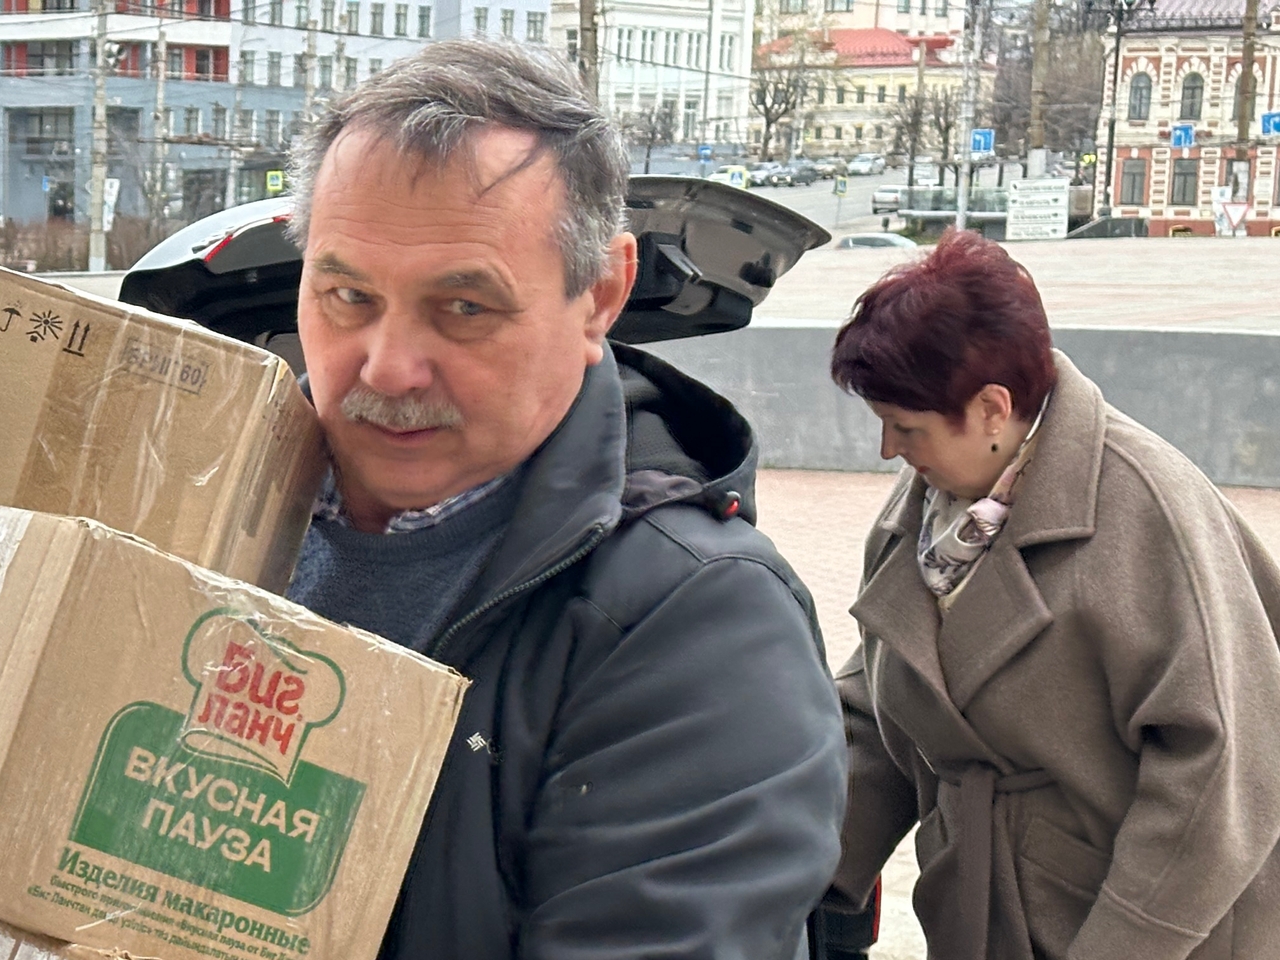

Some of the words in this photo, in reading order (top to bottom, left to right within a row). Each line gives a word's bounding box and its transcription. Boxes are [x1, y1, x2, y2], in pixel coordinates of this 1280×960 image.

[124, 746, 320, 844] ВКУСНАЯ
[142, 798, 271, 873] ПАУЗА
[57, 847, 160, 903] Изделия
[161, 890, 311, 955] макаронные
